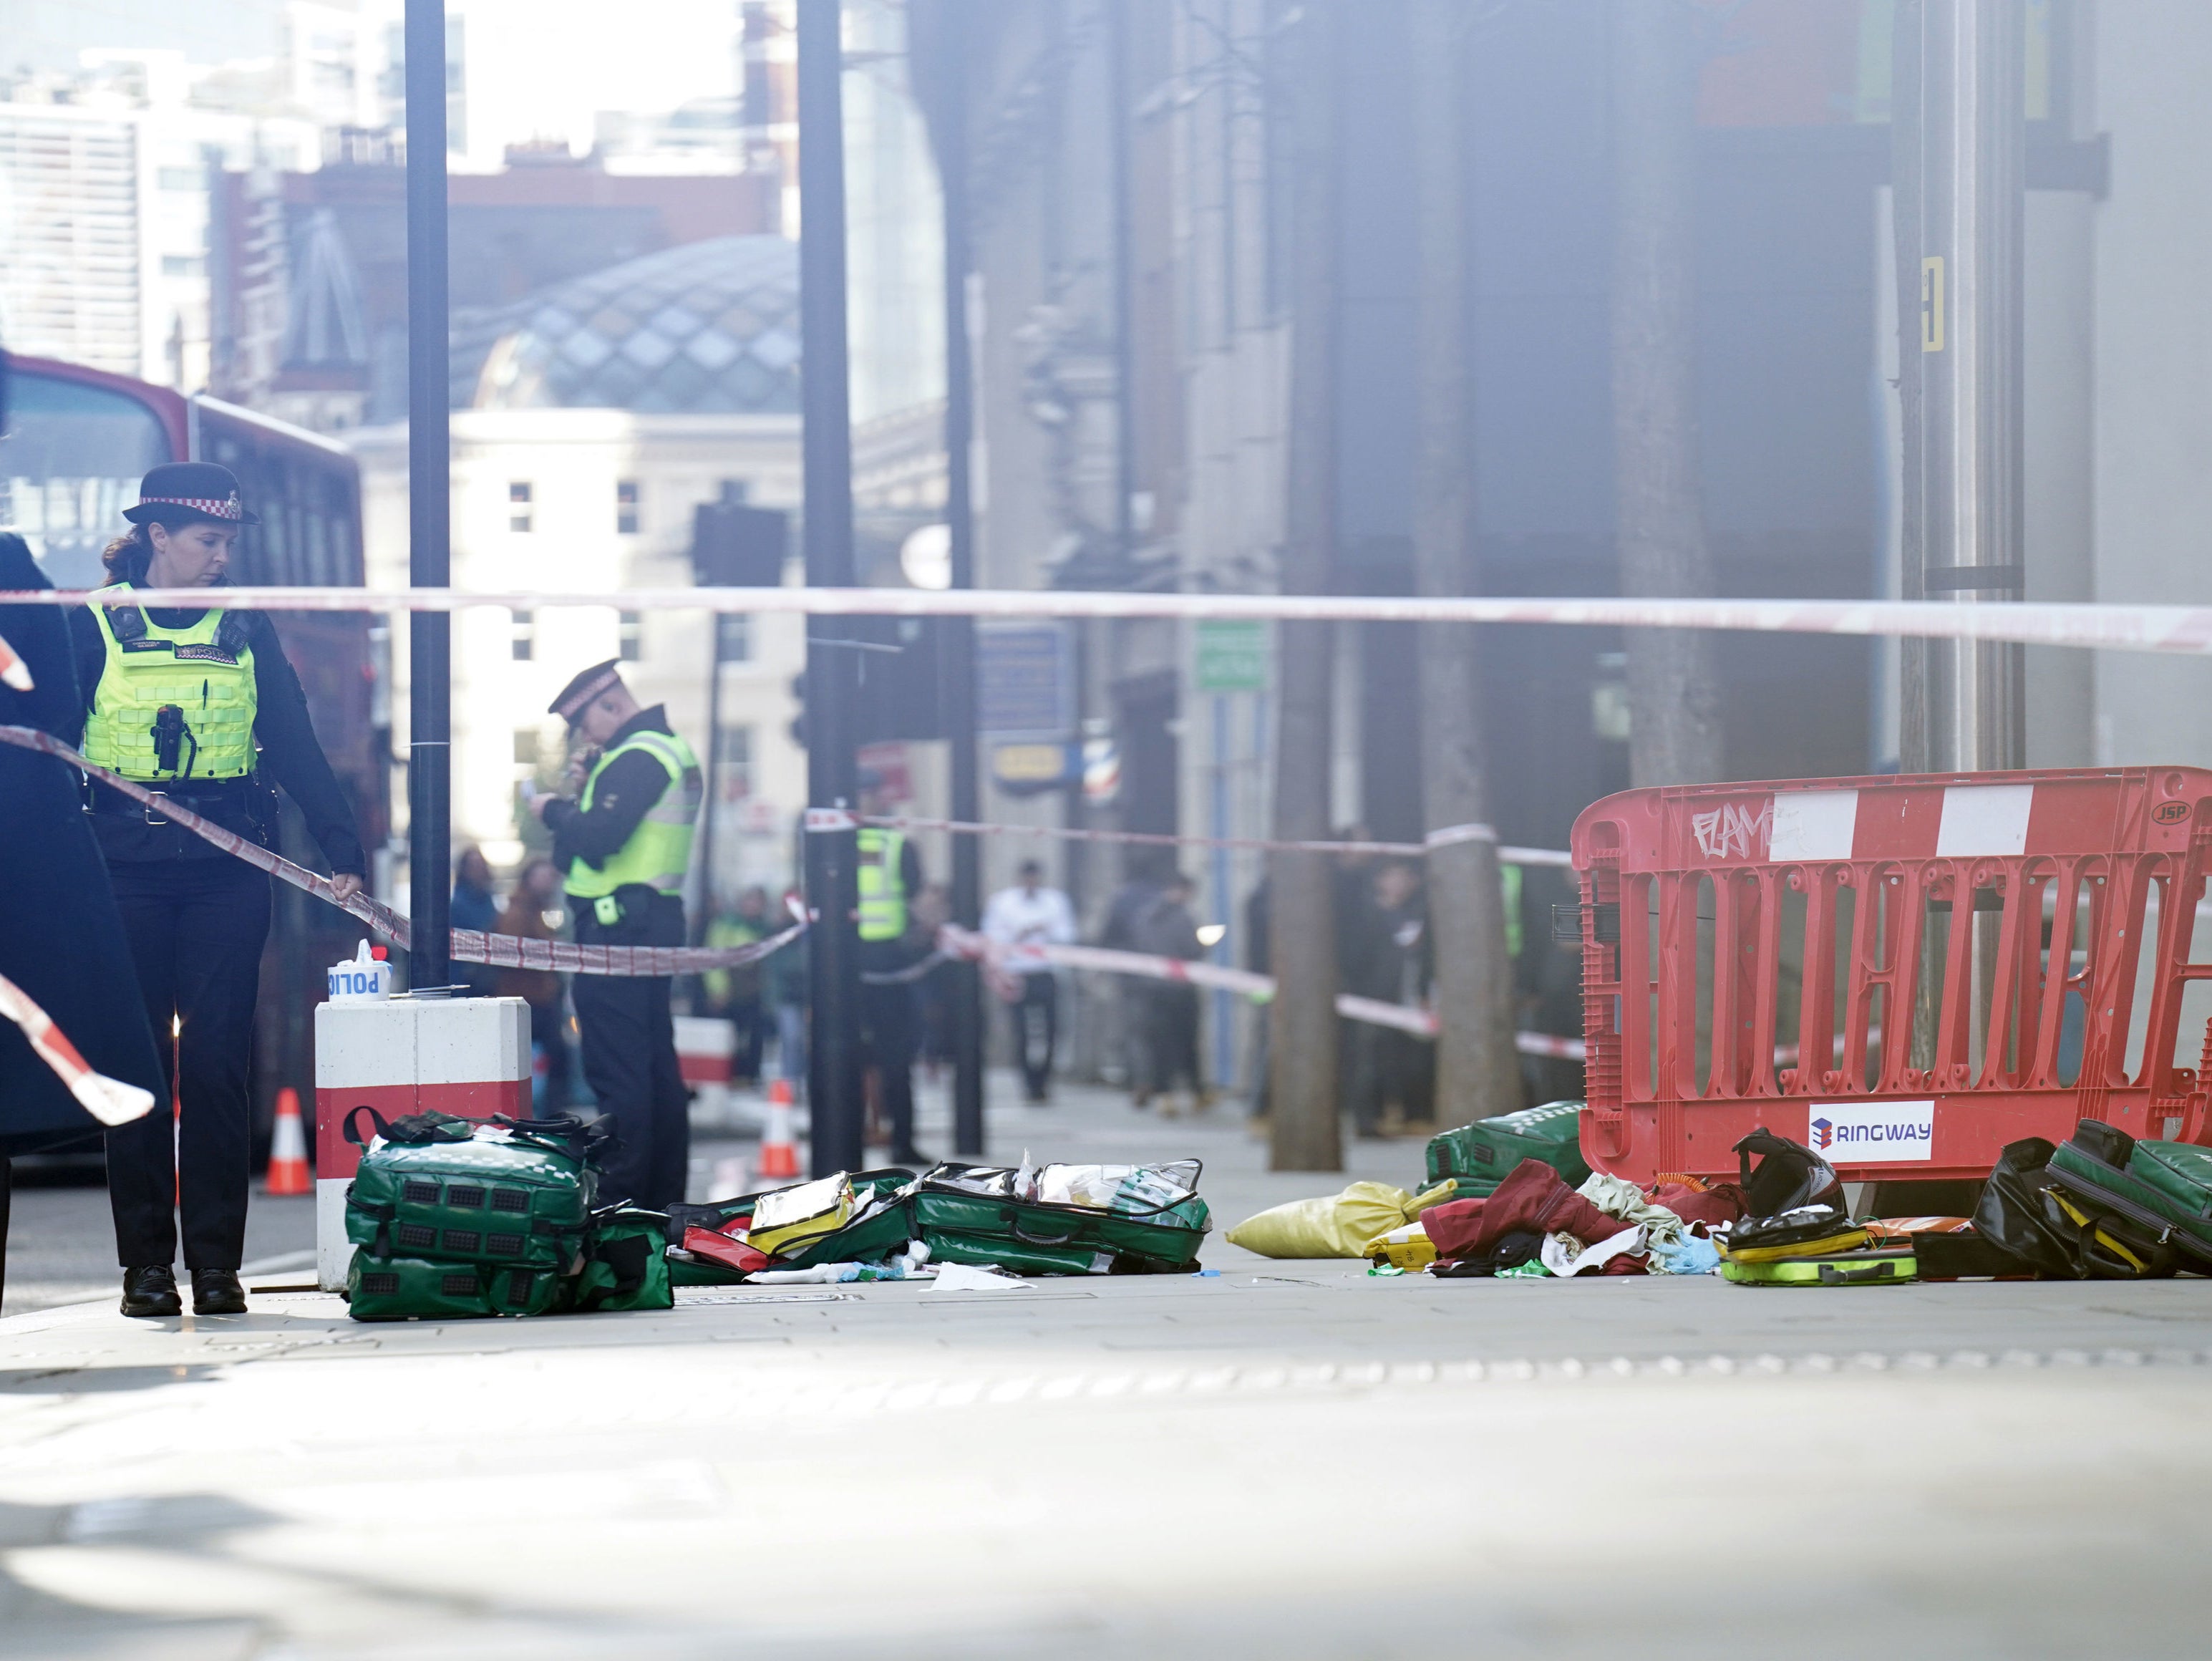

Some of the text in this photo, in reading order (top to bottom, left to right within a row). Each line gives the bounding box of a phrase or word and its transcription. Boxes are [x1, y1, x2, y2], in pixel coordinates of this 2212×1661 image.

[2157, 805, 2186, 820] JSP
[1692, 798, 1793, 859] FLAM
[1837, 1123, 1931, 1142] RINGWAY
